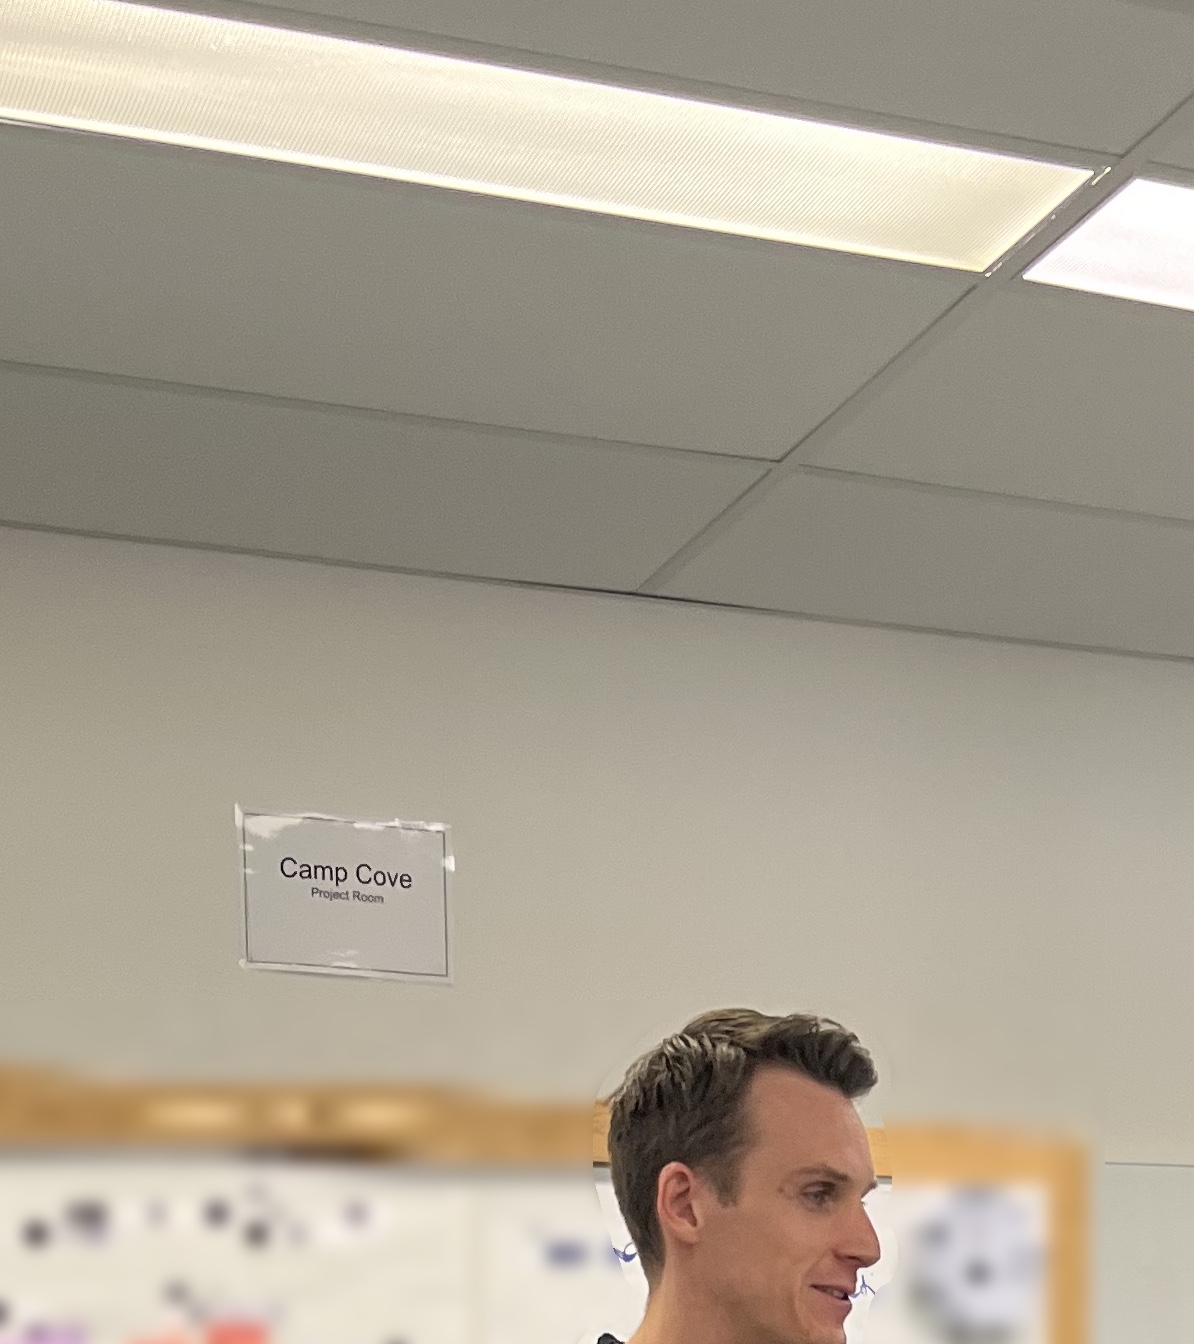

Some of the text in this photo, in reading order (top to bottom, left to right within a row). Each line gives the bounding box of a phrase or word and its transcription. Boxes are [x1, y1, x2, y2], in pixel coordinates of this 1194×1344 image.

[280, 857, 412, 889] Camp Cove
[311, 887, 384, 904] Project Room
